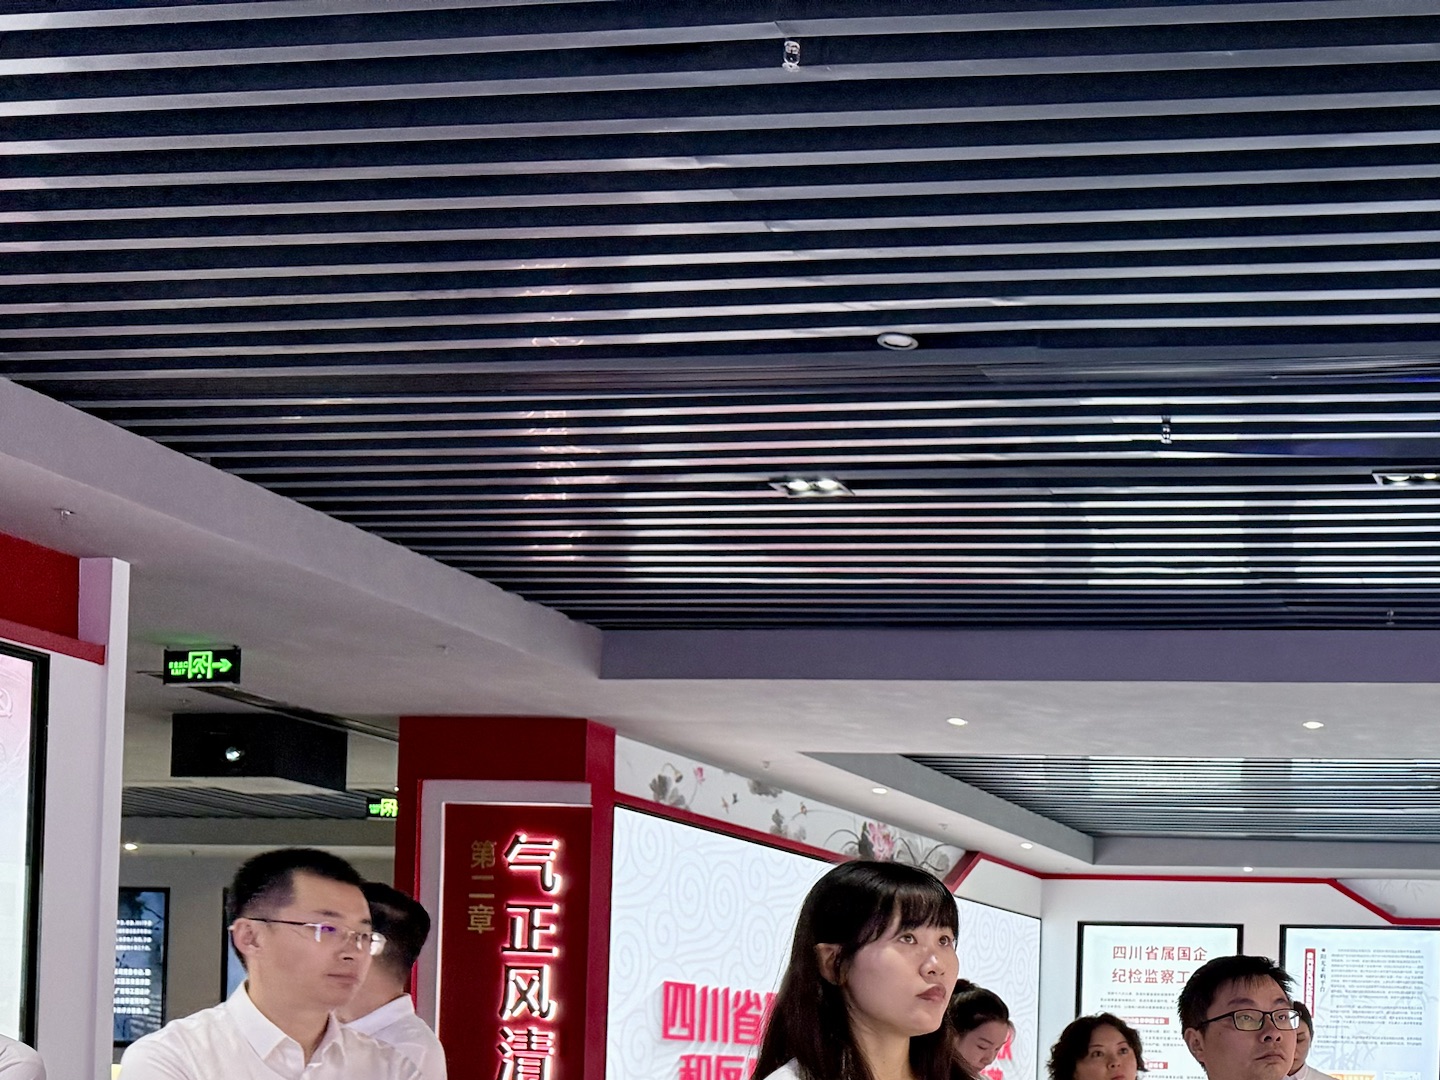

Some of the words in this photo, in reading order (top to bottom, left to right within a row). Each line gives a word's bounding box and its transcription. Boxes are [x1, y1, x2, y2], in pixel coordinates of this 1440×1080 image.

[468, 840, 496, 934] 第二章
[1112, 945, 1208, 962] 四川省属国企
[1111, 968, 1188, 984] 纪检监察工
[662, 980, 777, 1045] 四川省
